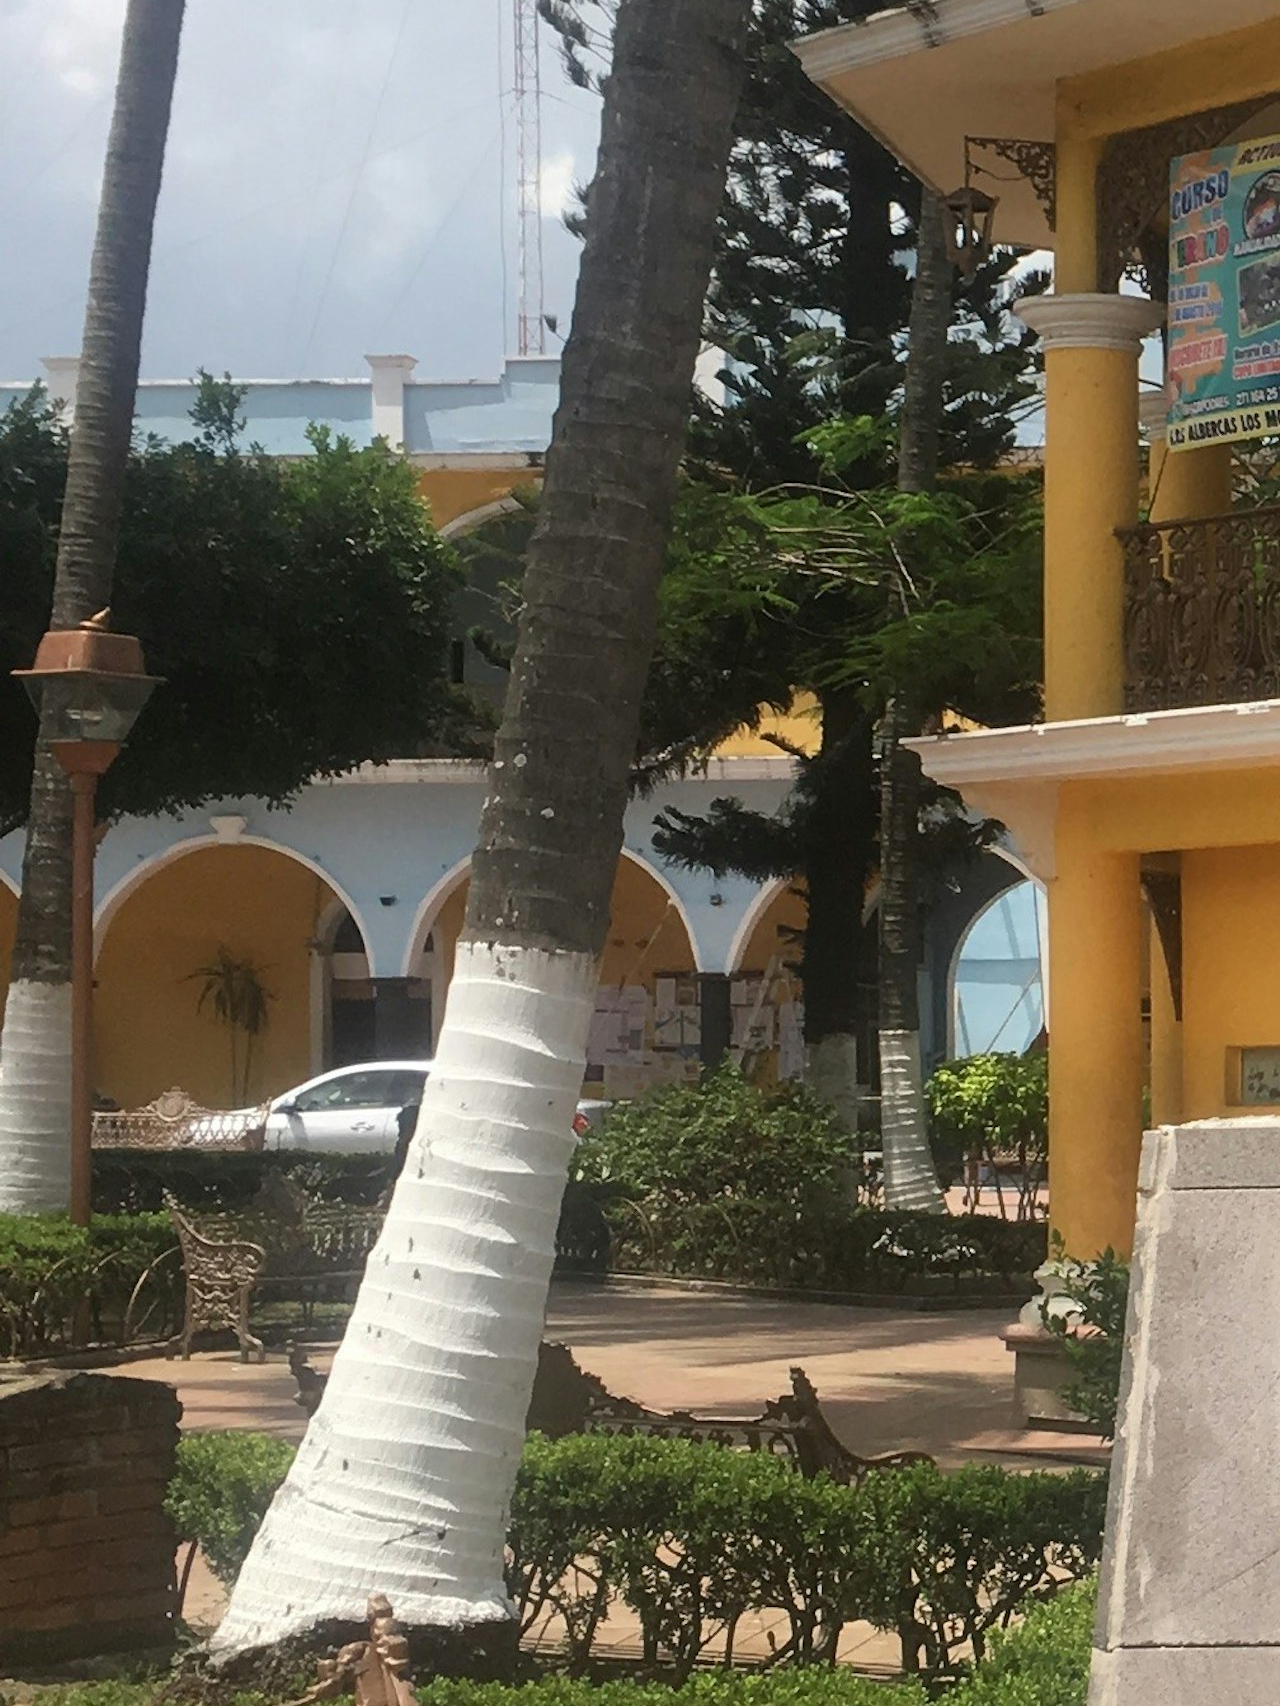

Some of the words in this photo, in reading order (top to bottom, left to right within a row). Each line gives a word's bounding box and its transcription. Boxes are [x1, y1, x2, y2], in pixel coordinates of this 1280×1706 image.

[1172, 169, 1230, 221] CURSO
[1169, 427, 1185, 446] LAS
[1188, 416, 1238, 441] ALBERCAS
[1240, 412, 1261, 432] LOS
